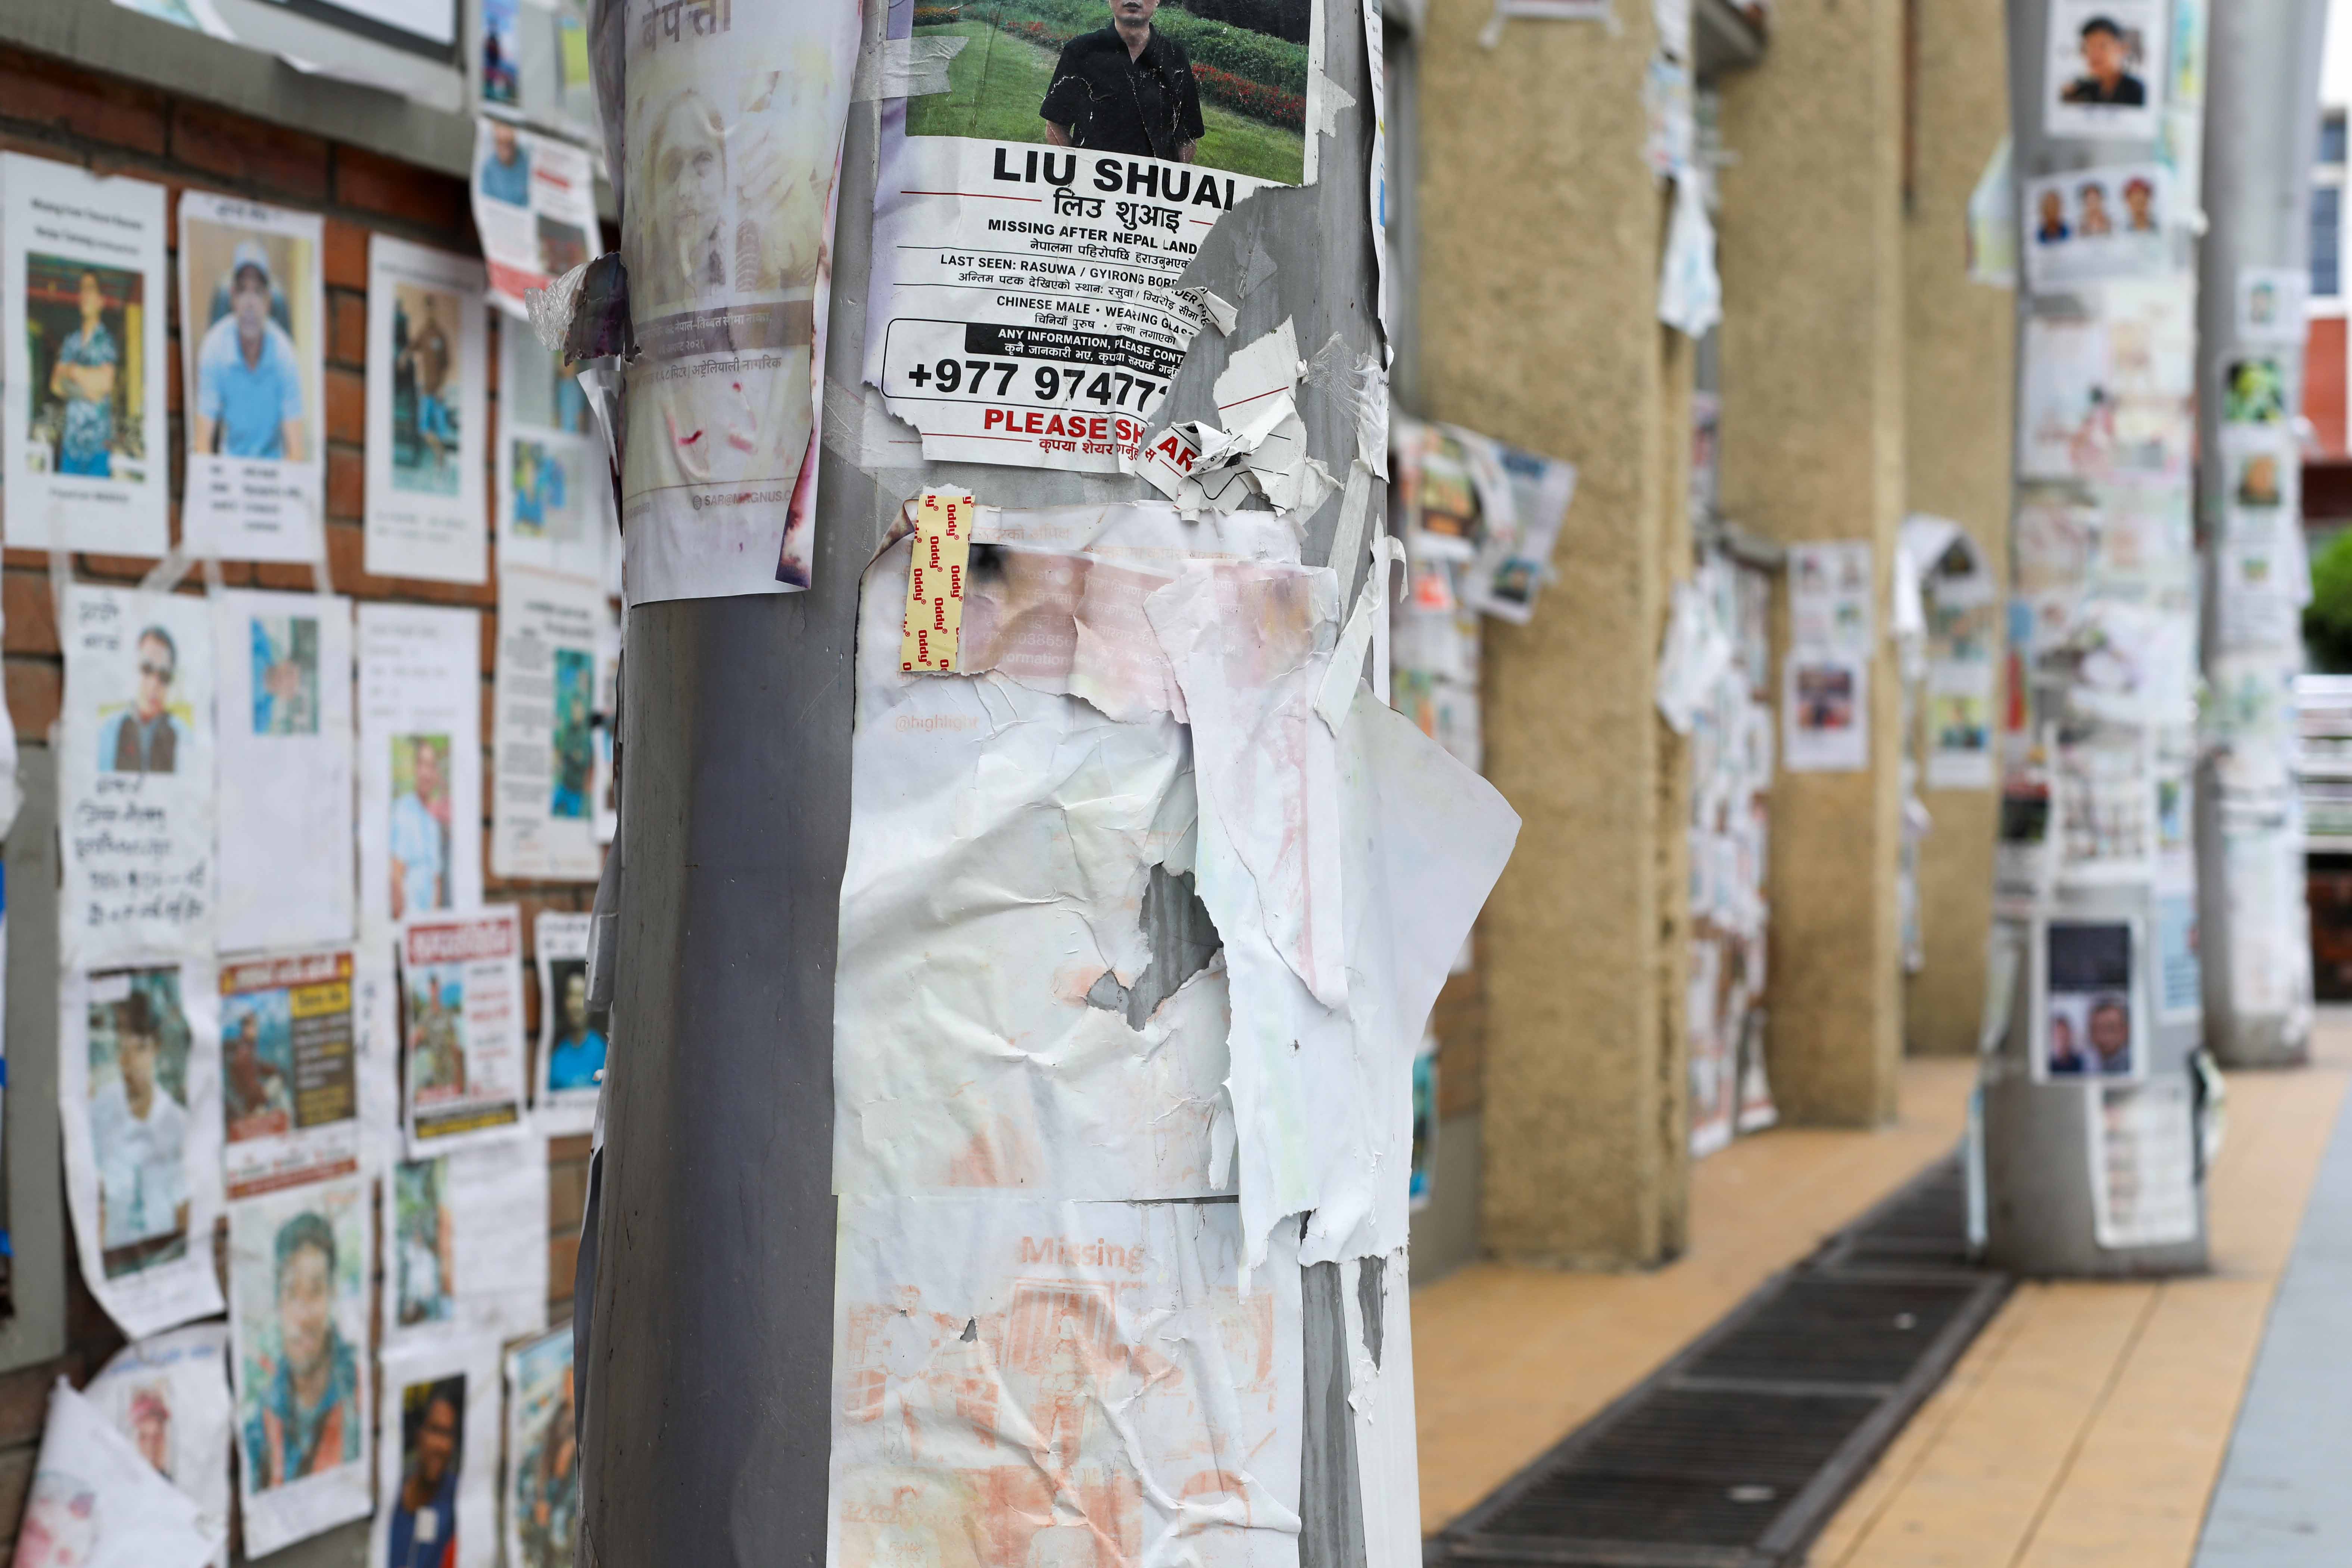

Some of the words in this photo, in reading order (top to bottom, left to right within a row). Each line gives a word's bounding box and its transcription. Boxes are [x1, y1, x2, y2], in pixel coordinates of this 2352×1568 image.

[993, 147, 1076, 186] LIU
[1093, 158, 1235, 211] SHUAI
[1053, 187, 1105, 218] लिउ
[1116, 201, 1182, 234] शुआइ
[988, 219, 1054, 236] MISSING
[1059, 226, 1107, 241] AFTER
[1113, 232, 1158, 249] NEPAL
[1030, 238, 1073, 253] नेपालमा
[1078, 243, 1130, 261] पहिरोपछि
[941, 254, 974, 267] LAST
[978, 258, 1016, 270] SEEN:
[1020, 261, 1076, 276] RASUWA
[1090, 268, 1144, 284] GYIRONG
[958, 271, 993, 283] अन्तिम
[999, 276, 1024, 285] पटक
[1029, 277, 1070, 290] देखिएको
[1075, 283, 1103, 294] स्थान:
[1108, 286, 1133, 299] रसुवा
[1179, 305, 1199, 322] सीमा
[996, 296, 1052, 310] CHINESE
[1056, 300, 1090, 314] MALE
[1035, 313, 1068, 326] चिनियाँ
[1073, 319, 1095, 330] पुरुष
[1116, 322, 1135, 334] चस्मा
[998, 328, 1024, 339] ANY
[1027, 330, 1111, 350] INFORMATION,
[1114, 339, 1151, 356] PLEASE
[742, 354, 782, 370] नागरिक
[1028, 345, 1071, 358] जानकारी
[1075, 350, 1094, 361] भए,
[1098, 352, 1125, 365] कृपया
[1128, 355, 1155, 370] सम्पर्क
[909, 358, 1018, 396] +977
[1035, 366, 1169, 412] 97477
[984, 409, 1108, 440] PLEASE
[1039, 438, 1076, 454] कृपया
[1082, 439, 1114, 455] शेयर
[1021, 1235, 1145, 1274] Missing
